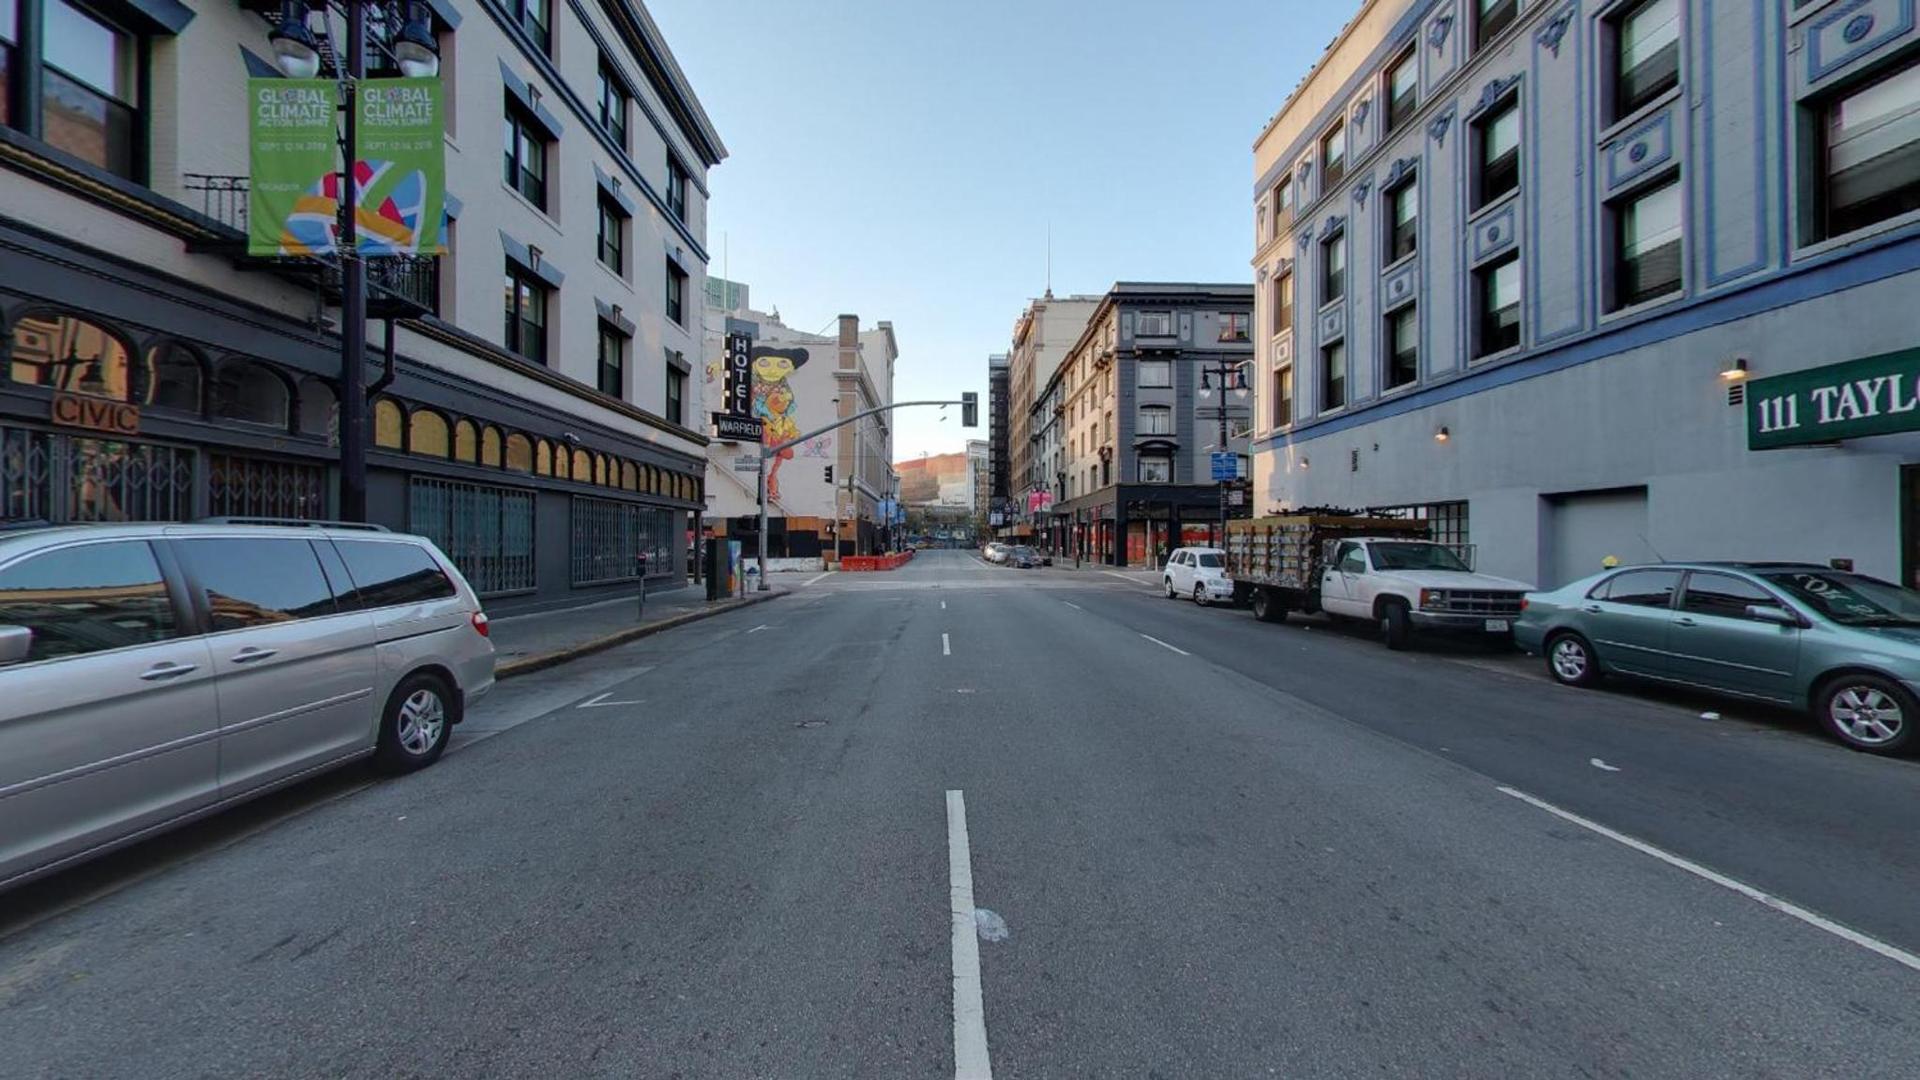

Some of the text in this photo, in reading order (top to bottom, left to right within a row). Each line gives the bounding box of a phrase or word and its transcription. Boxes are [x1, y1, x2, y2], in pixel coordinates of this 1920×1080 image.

[258, 88, 330, 104] GLOBAL
[364, 87, 433, 102] GLOBAL
[258, 103, 330, 118] CLIMATE
[364, 103, 433, 118] CLIMATE
[257, 118, 294, 128] ACTION
[363, 118, 399, 127] ACTION
[735, 338, 748, 414] HOTEL
[1758, 374, 1920, 433] 111 TAYL
[55, 395, 137, 431] CIVIC
[719, 419, 762, 437] WARFIELD
